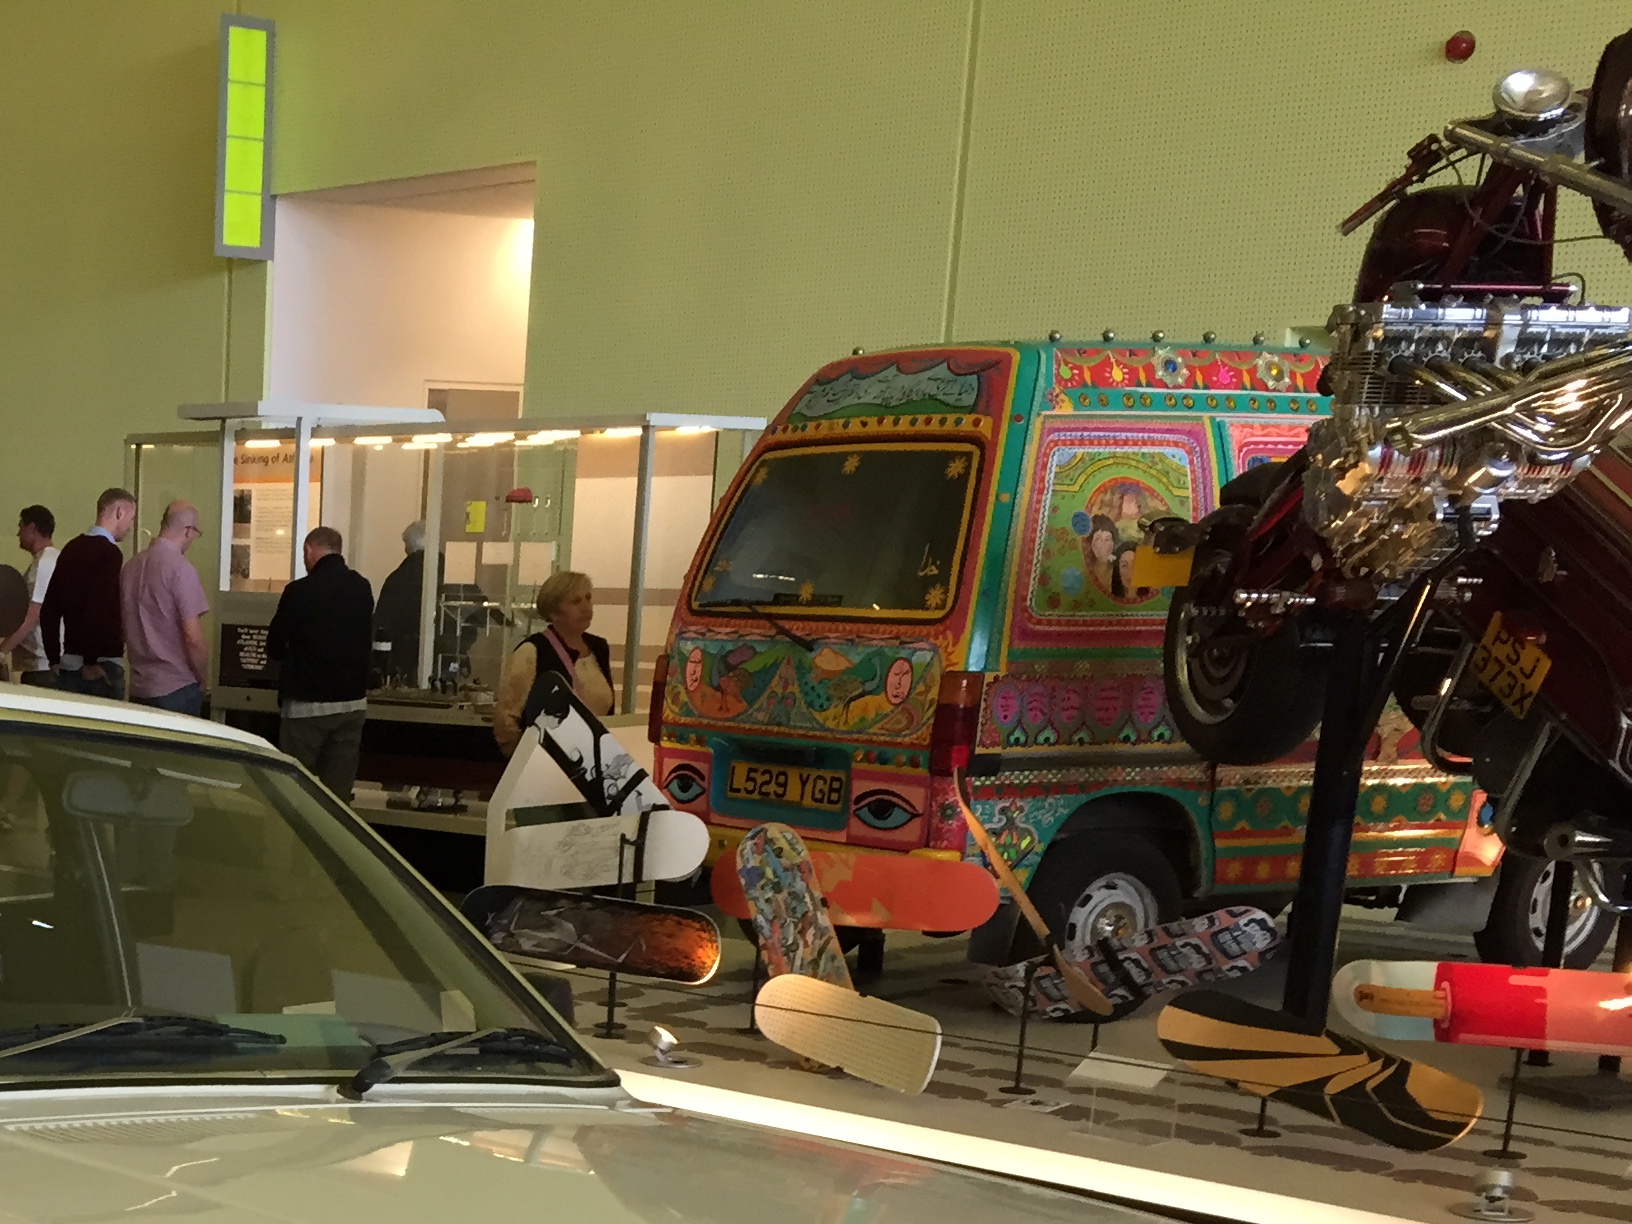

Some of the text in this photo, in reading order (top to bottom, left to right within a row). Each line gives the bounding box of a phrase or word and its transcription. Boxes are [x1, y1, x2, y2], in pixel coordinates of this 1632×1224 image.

[241, 451, 269, 467] Sinking
[271, 451, 280, 464] of
[1492, 629, 1540, 681] PSJ
[1469, 645, 1534, 716] 373X
[728, 765, 845, 806] L529 YGB
